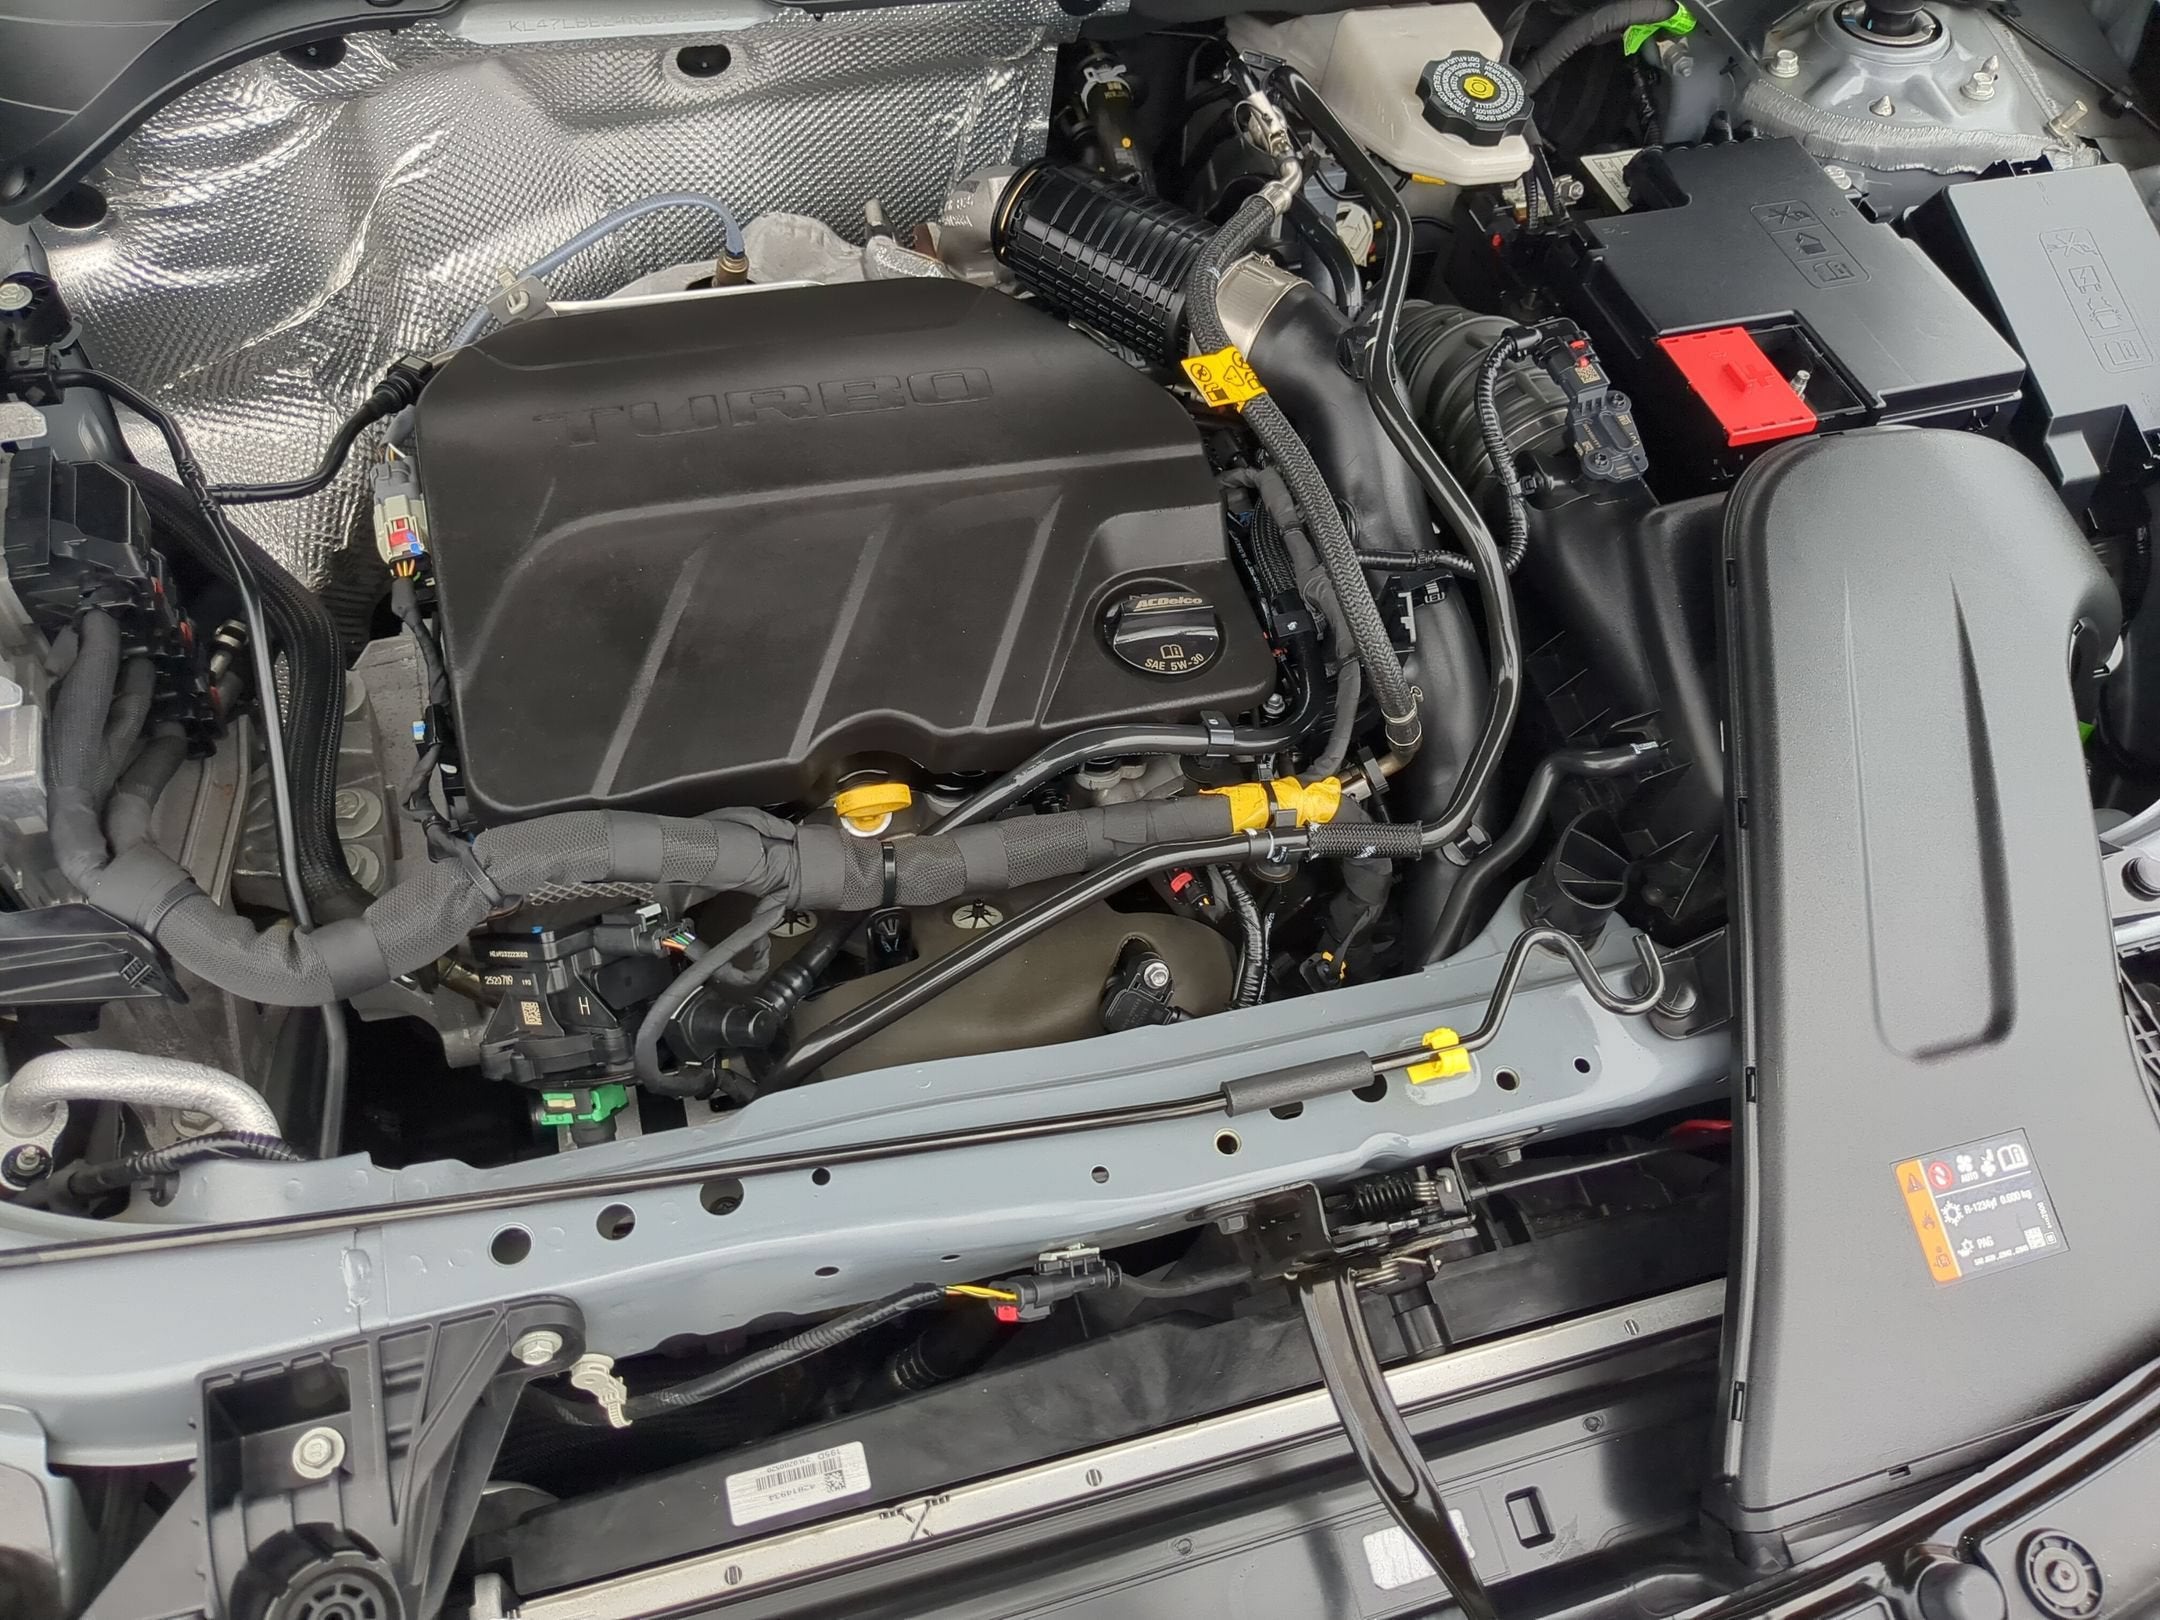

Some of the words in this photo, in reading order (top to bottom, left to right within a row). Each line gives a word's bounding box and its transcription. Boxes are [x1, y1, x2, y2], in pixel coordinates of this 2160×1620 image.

[531, 366, 994, 447] TURBO
[1135, 596, 1203, 609] ACDelco
[1144, 658, 1166, 671] SAE
[1170, 653, 1205, 671] 5W-30
[578, 996, 591, 1016] H
[1960, 1171, 1979, 1183] AUTO
[1963, 1197, 1998, 1216] R-1234yf
[1976, 1236, 1995, 1249] PAG
